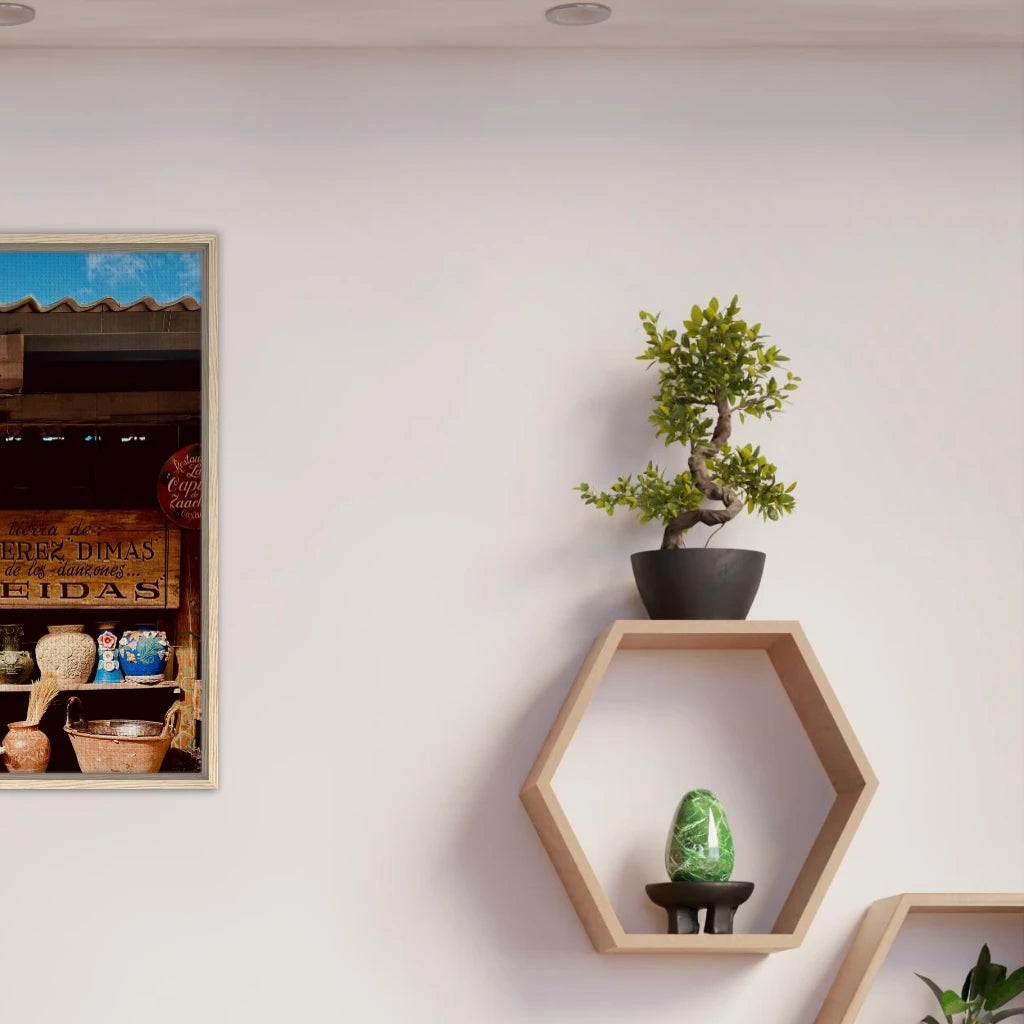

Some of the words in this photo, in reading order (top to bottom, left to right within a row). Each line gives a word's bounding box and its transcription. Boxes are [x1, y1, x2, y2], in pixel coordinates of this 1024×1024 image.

[167, 476, 202, 498] Capi
[8, 519, 58, 537] tierra
[5, 560, 21, 577] de
[28, 560, 46, 579] los
